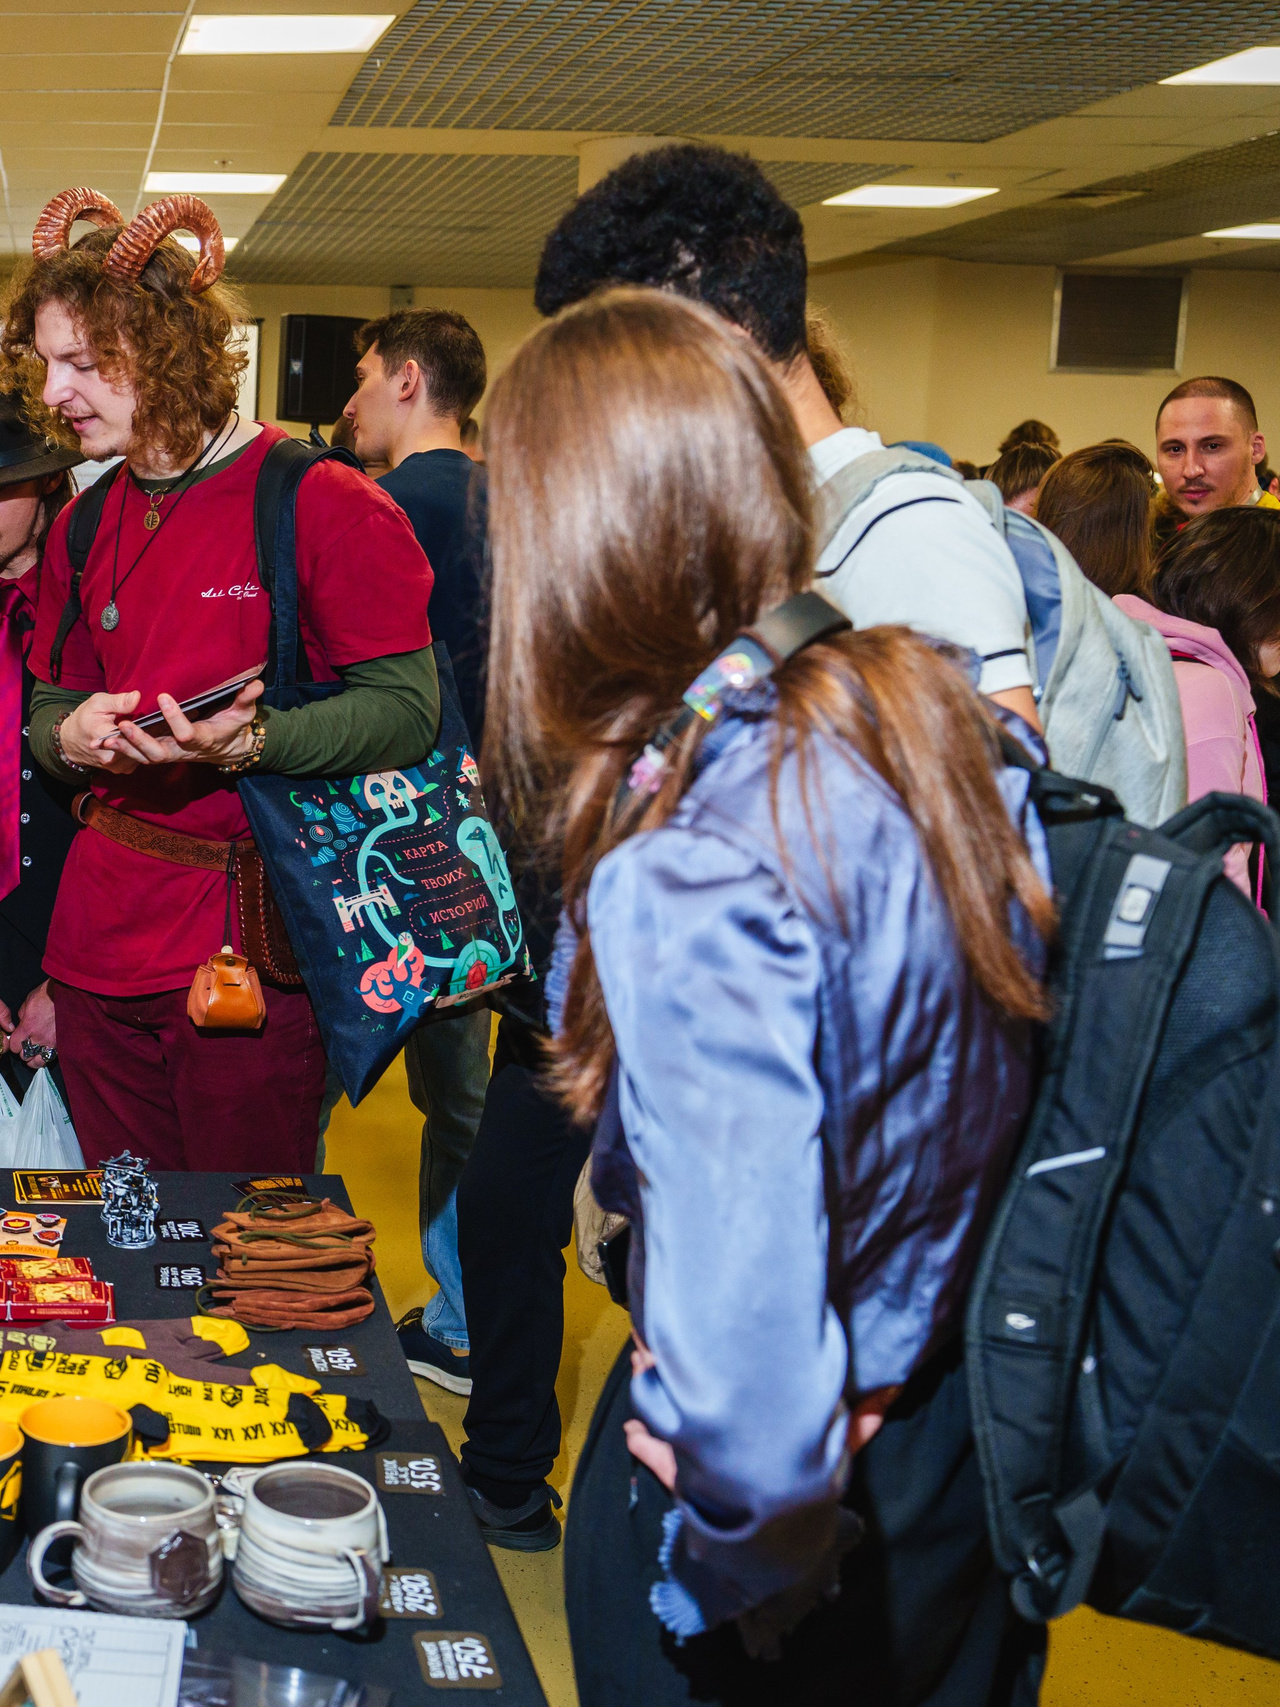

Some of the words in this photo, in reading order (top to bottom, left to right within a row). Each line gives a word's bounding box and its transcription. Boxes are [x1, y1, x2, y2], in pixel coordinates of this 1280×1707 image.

[402, 840, 449, 861] КАРТА
[421, 867, 467, 890] ТВОИХ
[429, 893, 489, 924] ИСТОРИЙ
[24, 1246, 50, 1254] LIVING
